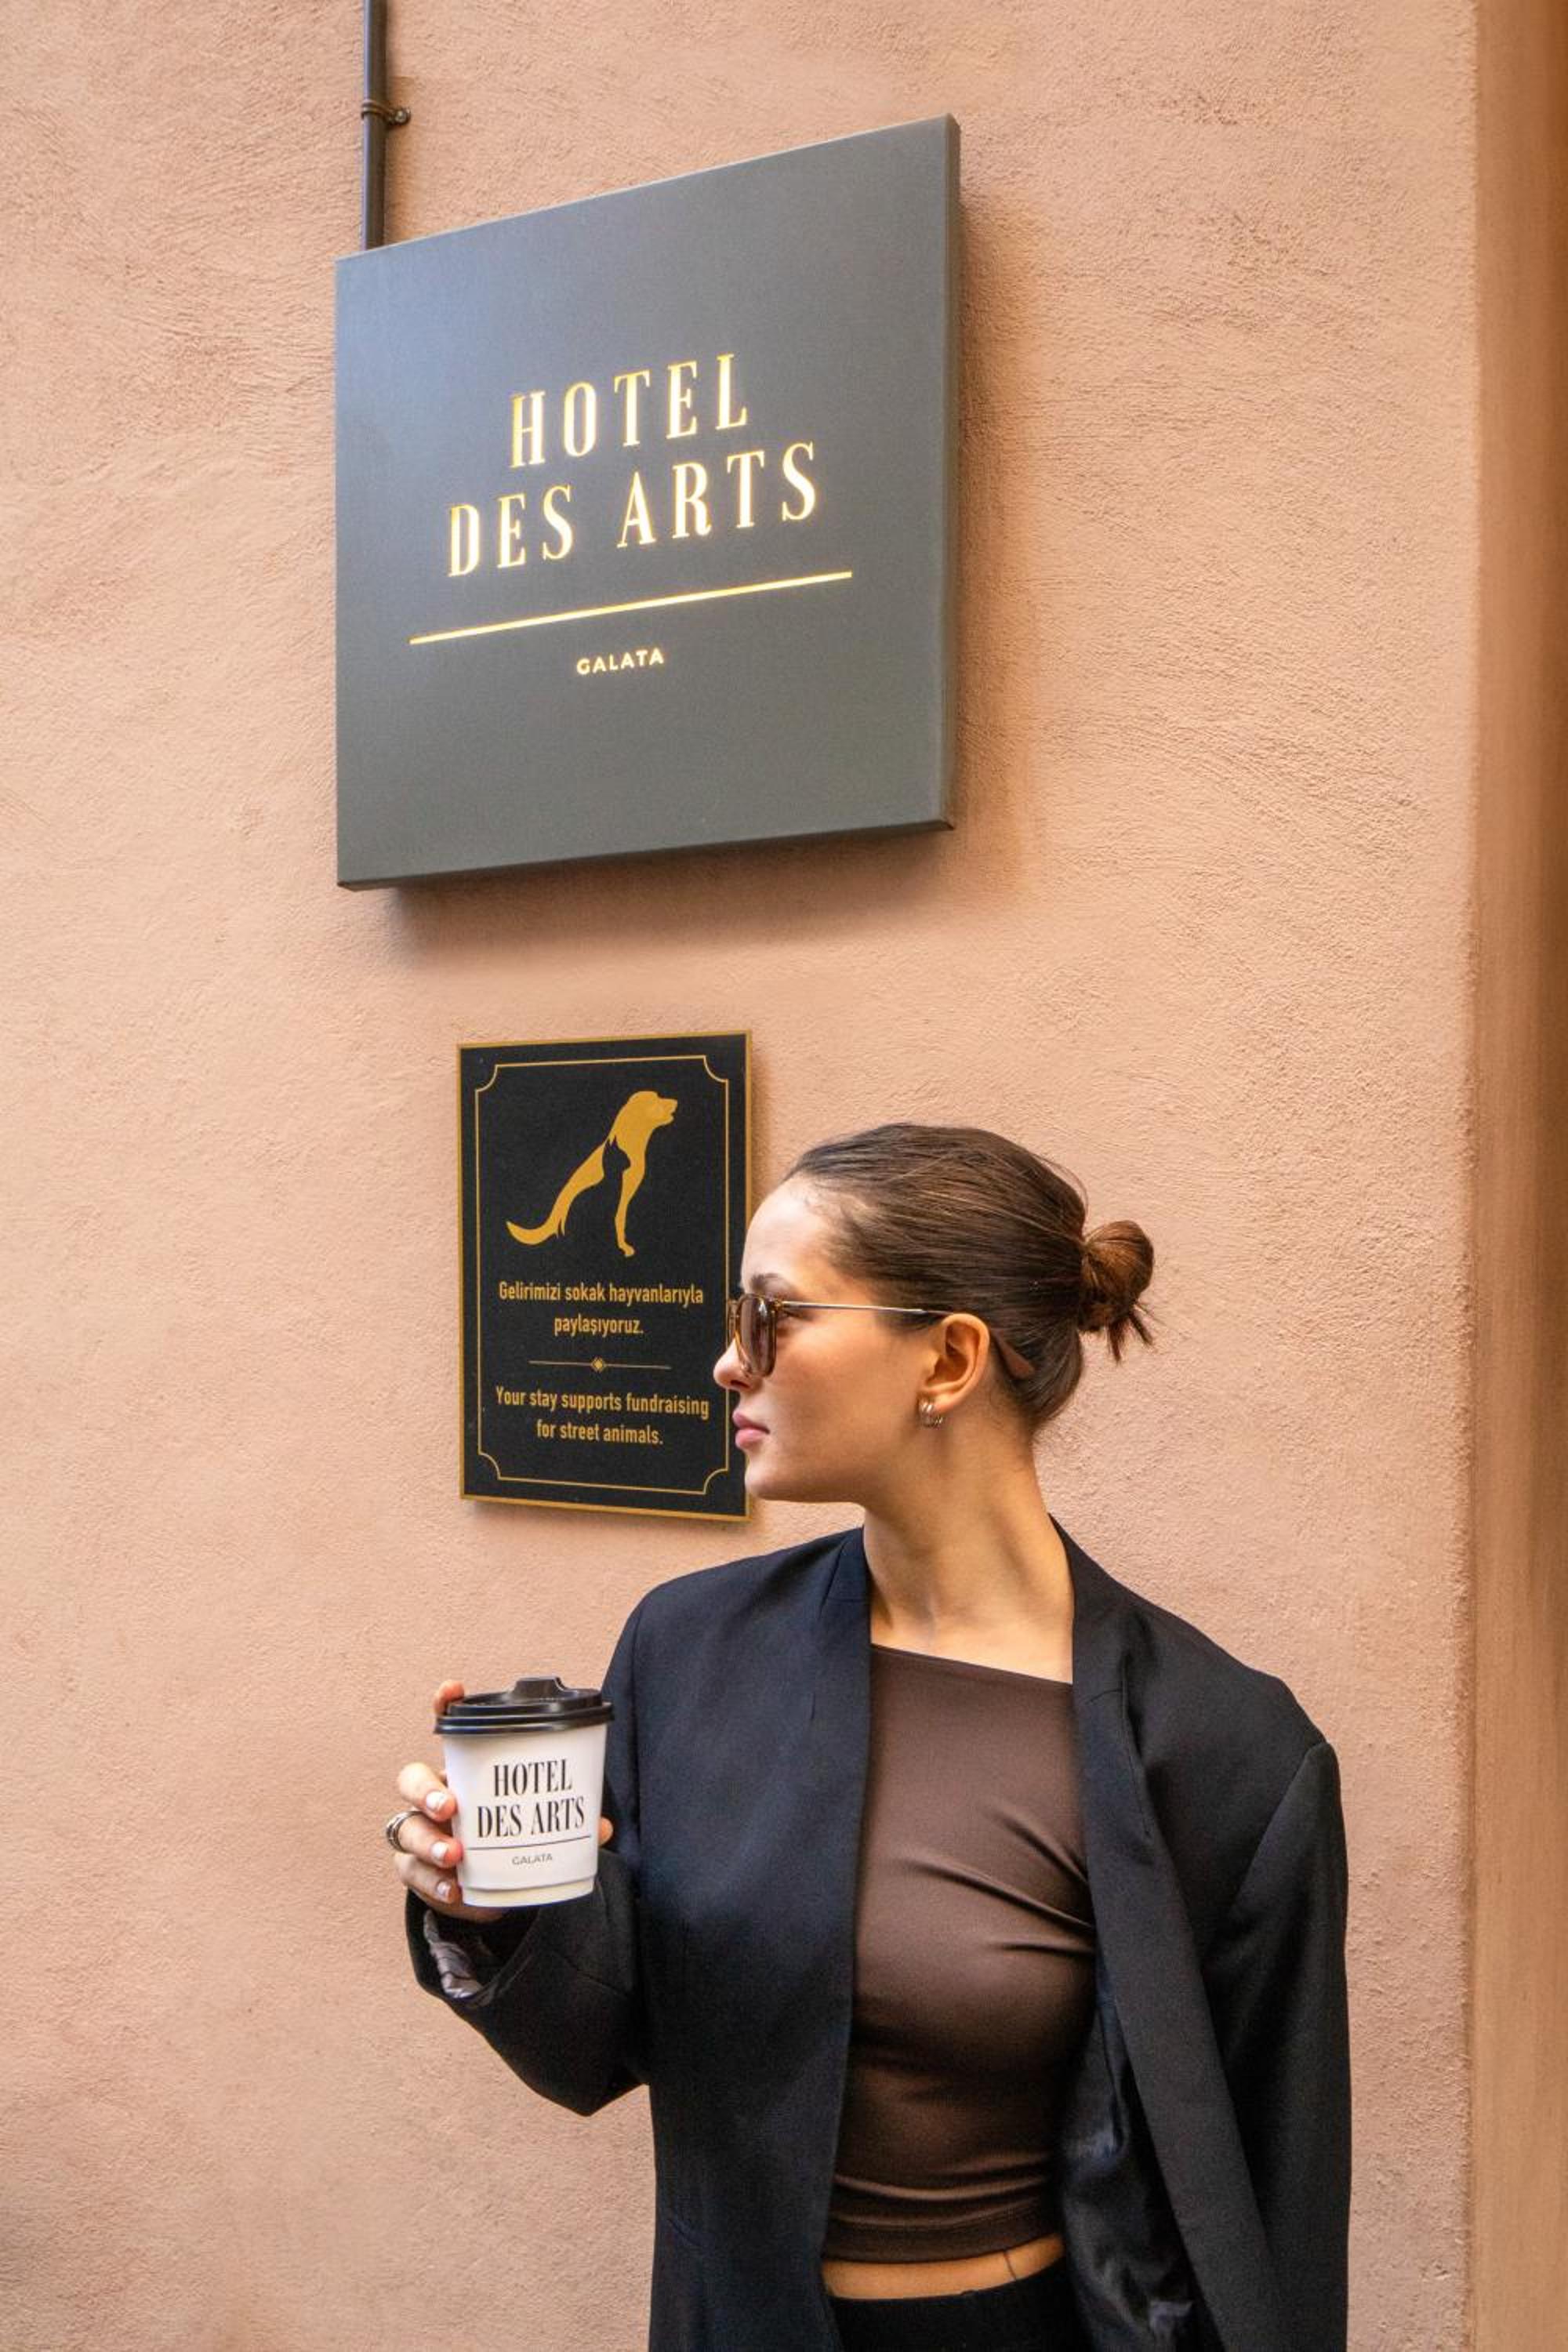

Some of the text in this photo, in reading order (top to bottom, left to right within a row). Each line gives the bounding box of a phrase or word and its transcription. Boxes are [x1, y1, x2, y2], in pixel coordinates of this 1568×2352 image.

[510, 354, 747, 469] HOTEL
[448, 441, 817, 578] DES ARTS
[575, 647, 665, 676] GALATA
[499, 1280, 704, 1308] Gelirimizi sokak hayvanlarıyla
[554, 1313, 644, 1338] paylaşıyoruz.
[495, 1385, 710, 1421] Your stay supports fundraising
[536, 1418, 664, 1445] for street animals.
[494, 1759, 573, 1797] HOTEL
[477, 1796, 585, 1838] DES ARTS
[511, 1853, 554, 1866] GALATA
